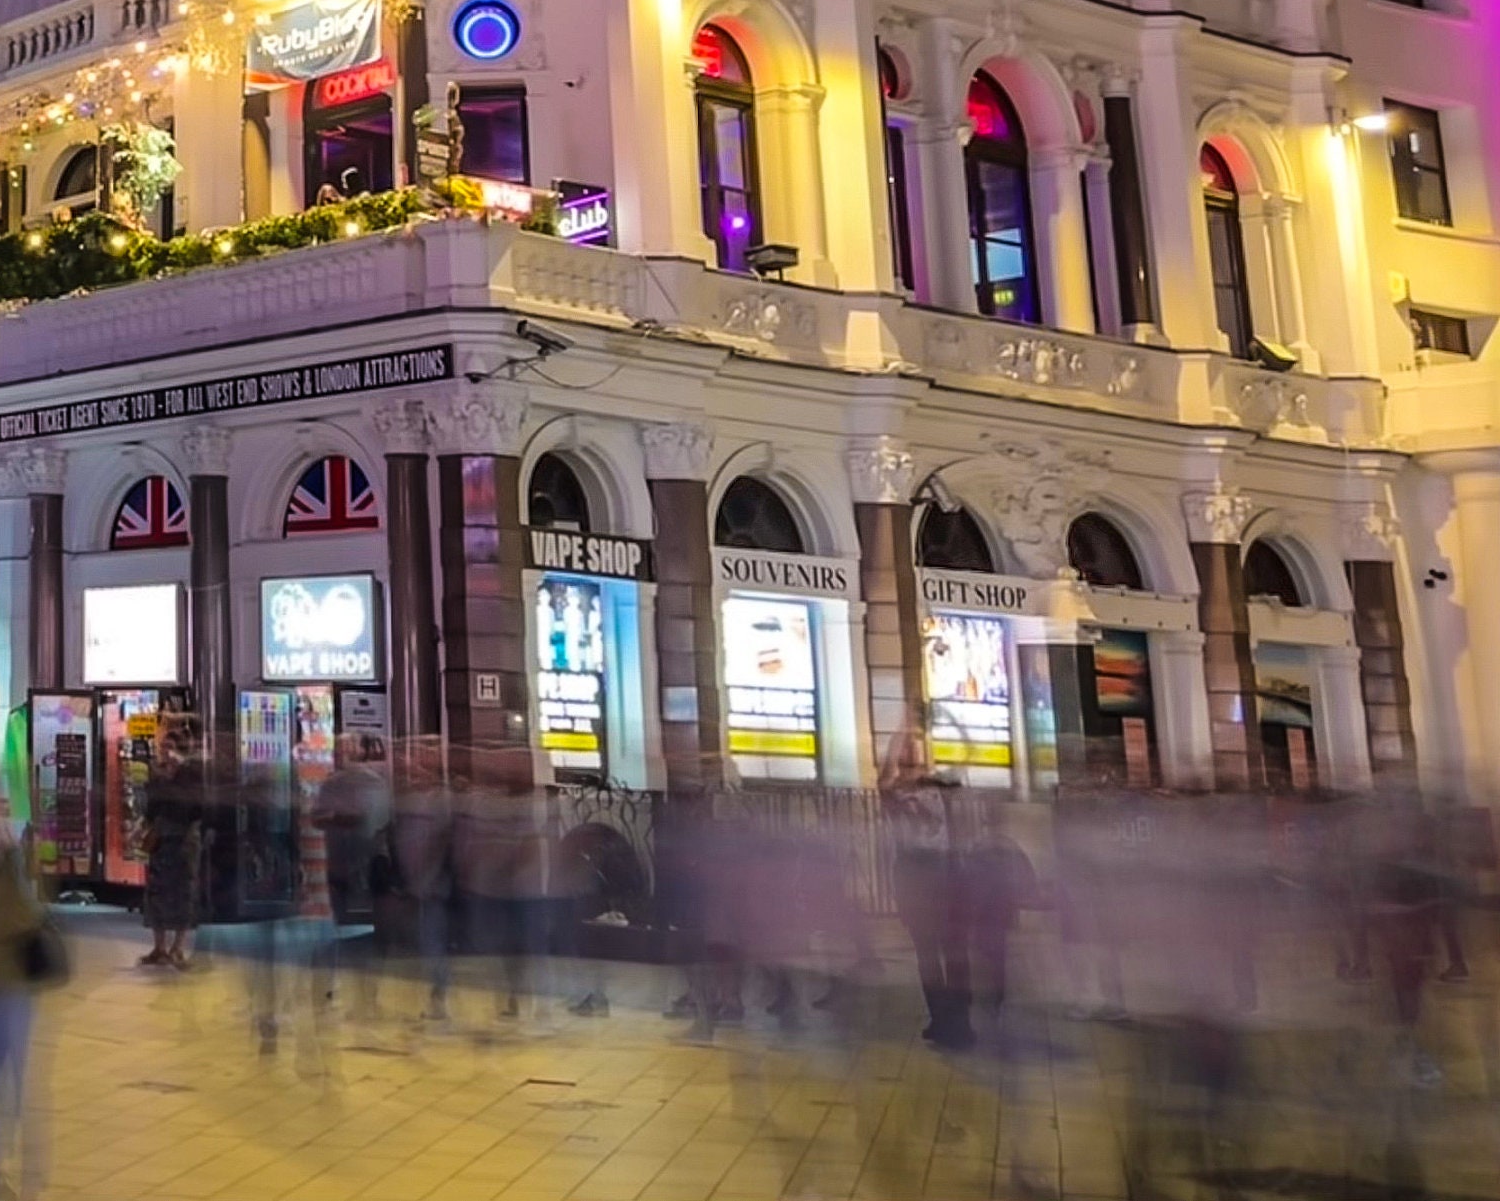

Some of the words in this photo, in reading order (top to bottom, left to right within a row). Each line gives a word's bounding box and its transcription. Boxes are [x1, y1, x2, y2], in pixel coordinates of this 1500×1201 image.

[558, 200, 608, 238] club
[0, 411, 36, 439] OFFICIAL
[38, 406, 67, 433] TICKET
[70, 401, 99, 429] AGENT
[100, 397, 129, 425] SINCE
[131, 393, 156, 420] 1970
[165, 390, 184, 415] FOR
[187, 386, 204, 412] ALL
[205, 380, 235, 409] WEST
[236, 377, 258, 405] END
[260, 371, 300, 401] SHOWS
[303, 369, 313, 395] &
[314, 361, 361, 394] LONDON
[363, 349, 445, 387] ATTRACTIONS
[531, 530, 583, 571] VAPE
[586, 537, 640, 576] SHOP
[721, 556, 847, 590] SOUVENIRS
[923, 578, 970, 604] GIFT
[974, 583, 1026, 609] SHOP
[267, 652, 313, 675] VAPE
[319, 651, 372, 675] SHOP
[480, 679, 497, 695] H
